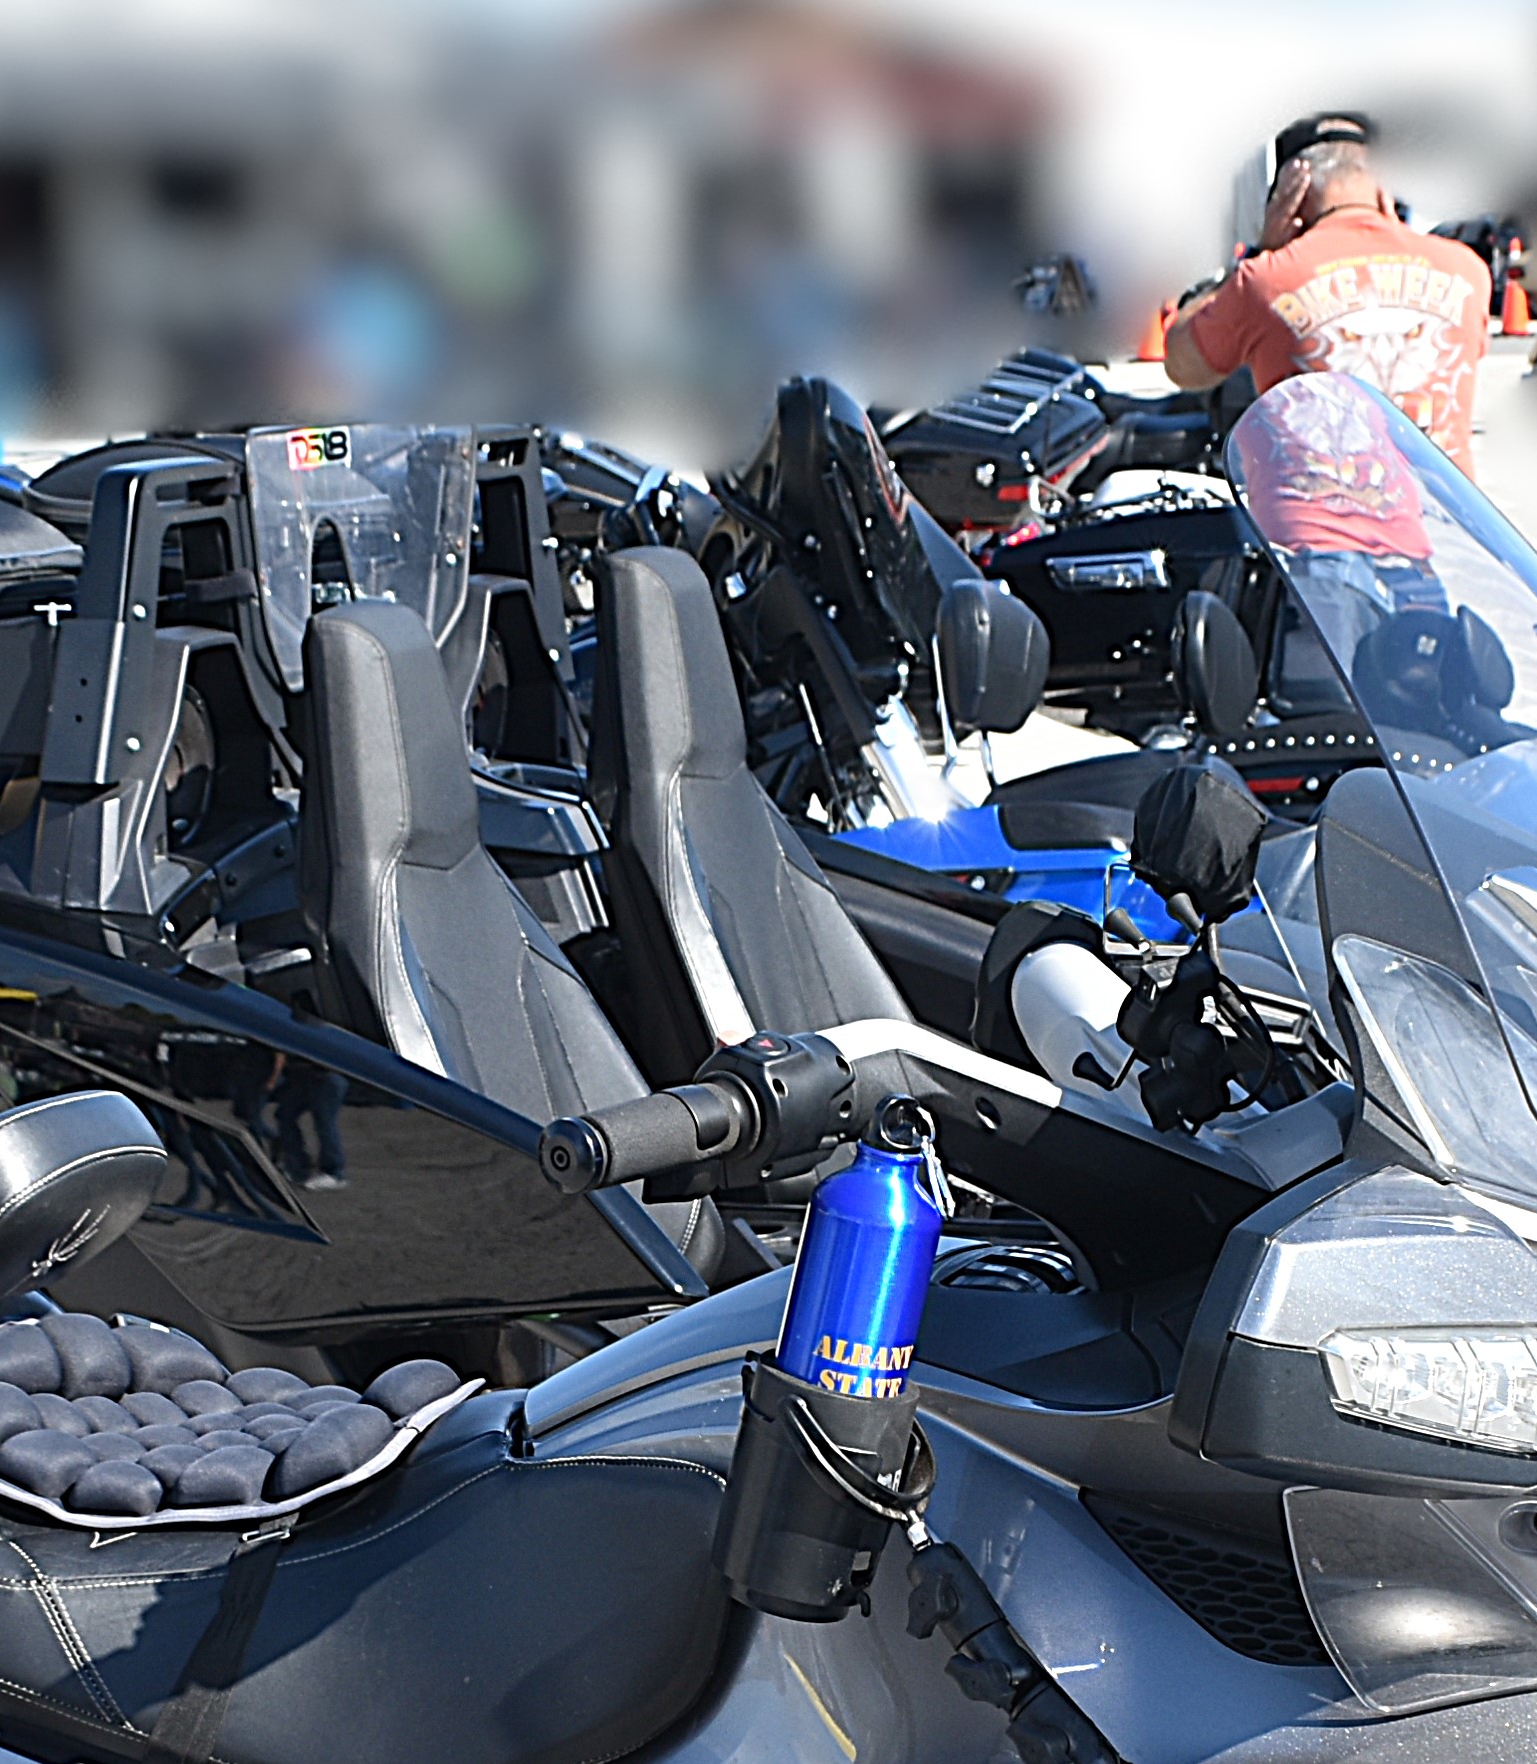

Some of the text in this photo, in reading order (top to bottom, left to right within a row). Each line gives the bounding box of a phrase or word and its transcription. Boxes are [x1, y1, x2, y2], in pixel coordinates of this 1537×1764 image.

[1270, 263, 1474, 339] BIKE WEEK
[813, 1335, 914, 1369] ALBANY
